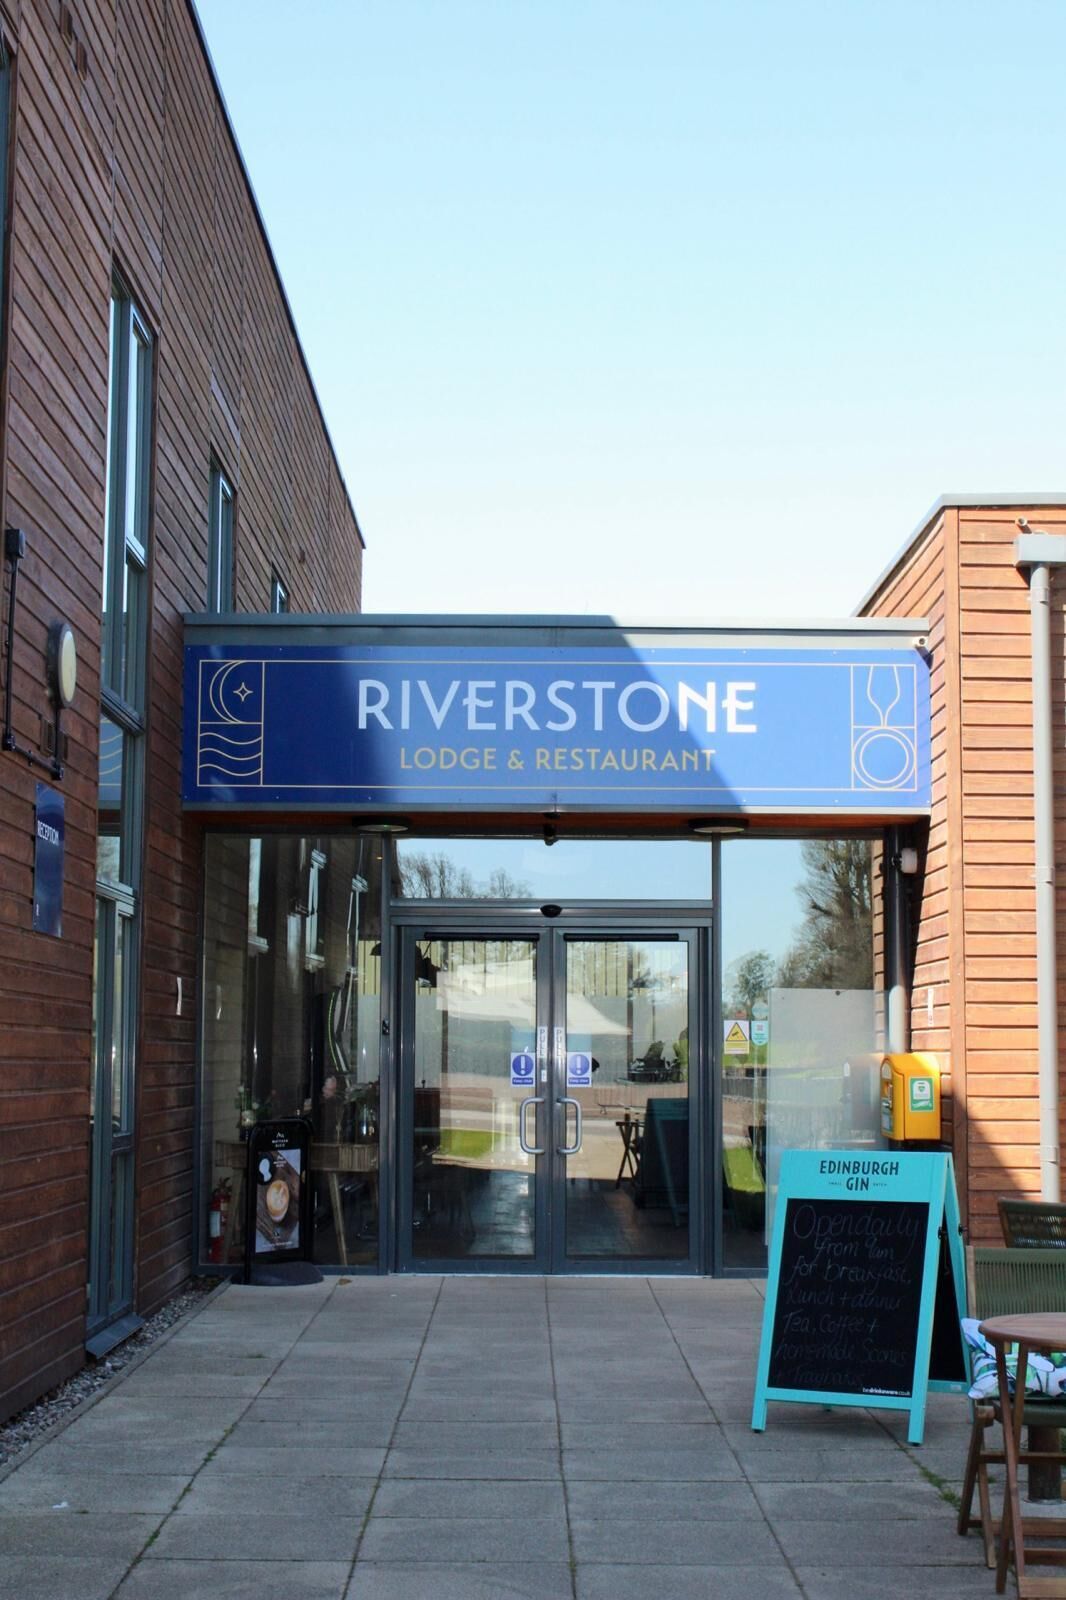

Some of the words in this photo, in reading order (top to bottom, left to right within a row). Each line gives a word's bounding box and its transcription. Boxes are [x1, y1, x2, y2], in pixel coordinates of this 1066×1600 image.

[358, 679, 758, 733] RIVERSTONE
[400, 747, 497, 770] LODGE
[507, 748, 525, 770] &
[535, 748, 717, 772] RESTAURANT
[37, 820, 60, 846] RECEPTION
[819, 1160, 899, 1176] EDINBURGH
[846, 1177, 870, 1191] GIN
[793, 1204, 853, 1248] Open
[855, 1206, 920, 1264] daily
[810, 1236, 859, 1265] from
[783, 1255, 818, 1286] for
[820, 1313, 865, 1345] Coffee
